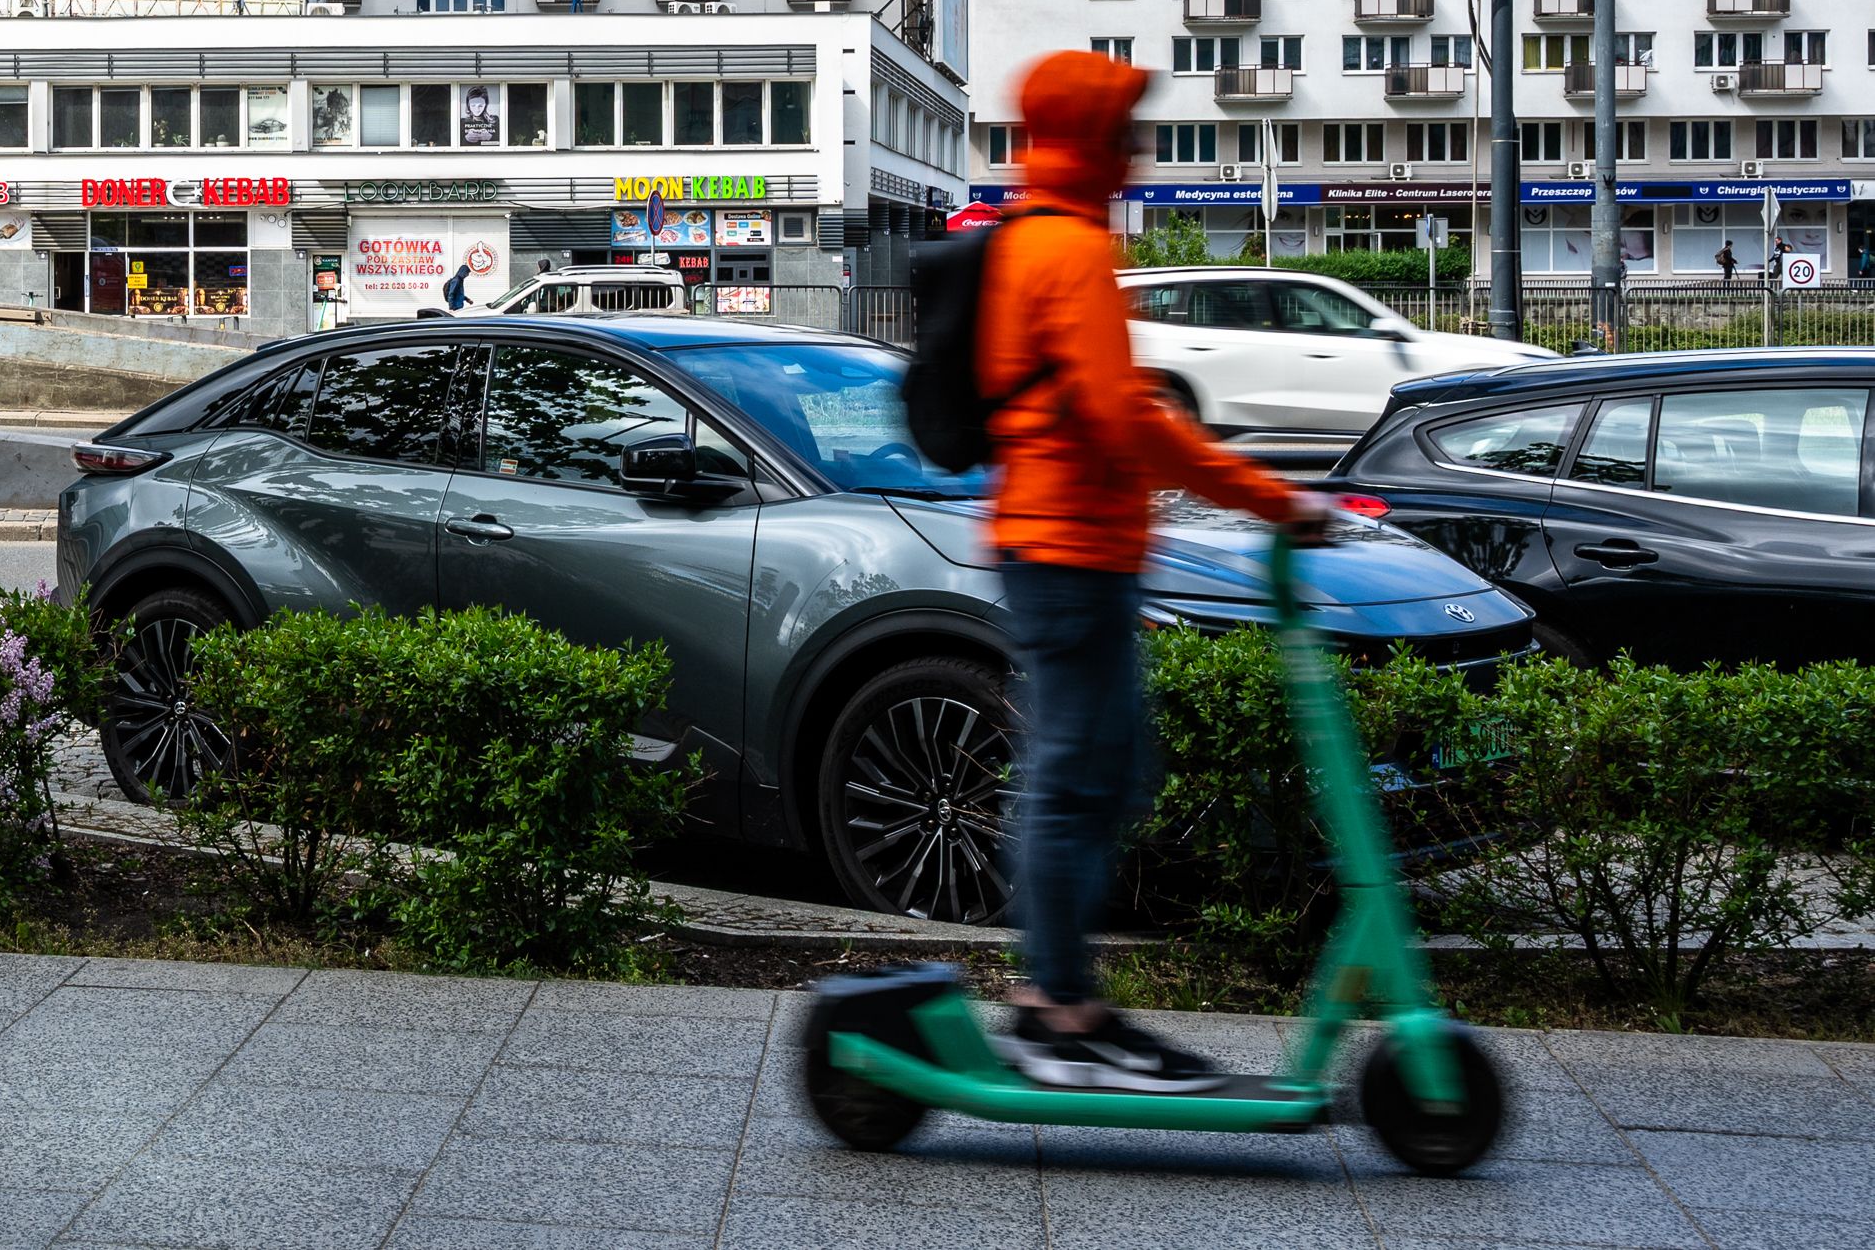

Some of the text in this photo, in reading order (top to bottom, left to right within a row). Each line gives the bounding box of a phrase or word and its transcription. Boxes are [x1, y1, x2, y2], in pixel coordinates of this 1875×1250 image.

[81, 177, 289, 207] DONER KEBAB
[613, 176, 766, 200] MOON KEBAB
[1328, 189, 1362, 197] Klinika
[1395, 189, 1437, 197] Centrum
[1531, 187, 1592, 197] Przeszczep
[1717, 185, 1765, 196] Chirurgia
[1175, 190, 1293, 200] Medycyna estetzna
[359, 237, 442, 254] GOTÓWKA
[366, 255, 435, 264] POD ZASTAW
[679, 256, 709, 268] KEBAB
[356, 264, 444, 275] WSZYSTKIEGO
[1793, 266, 1811, 278] 20
[380, 282, 389, 290] 22
